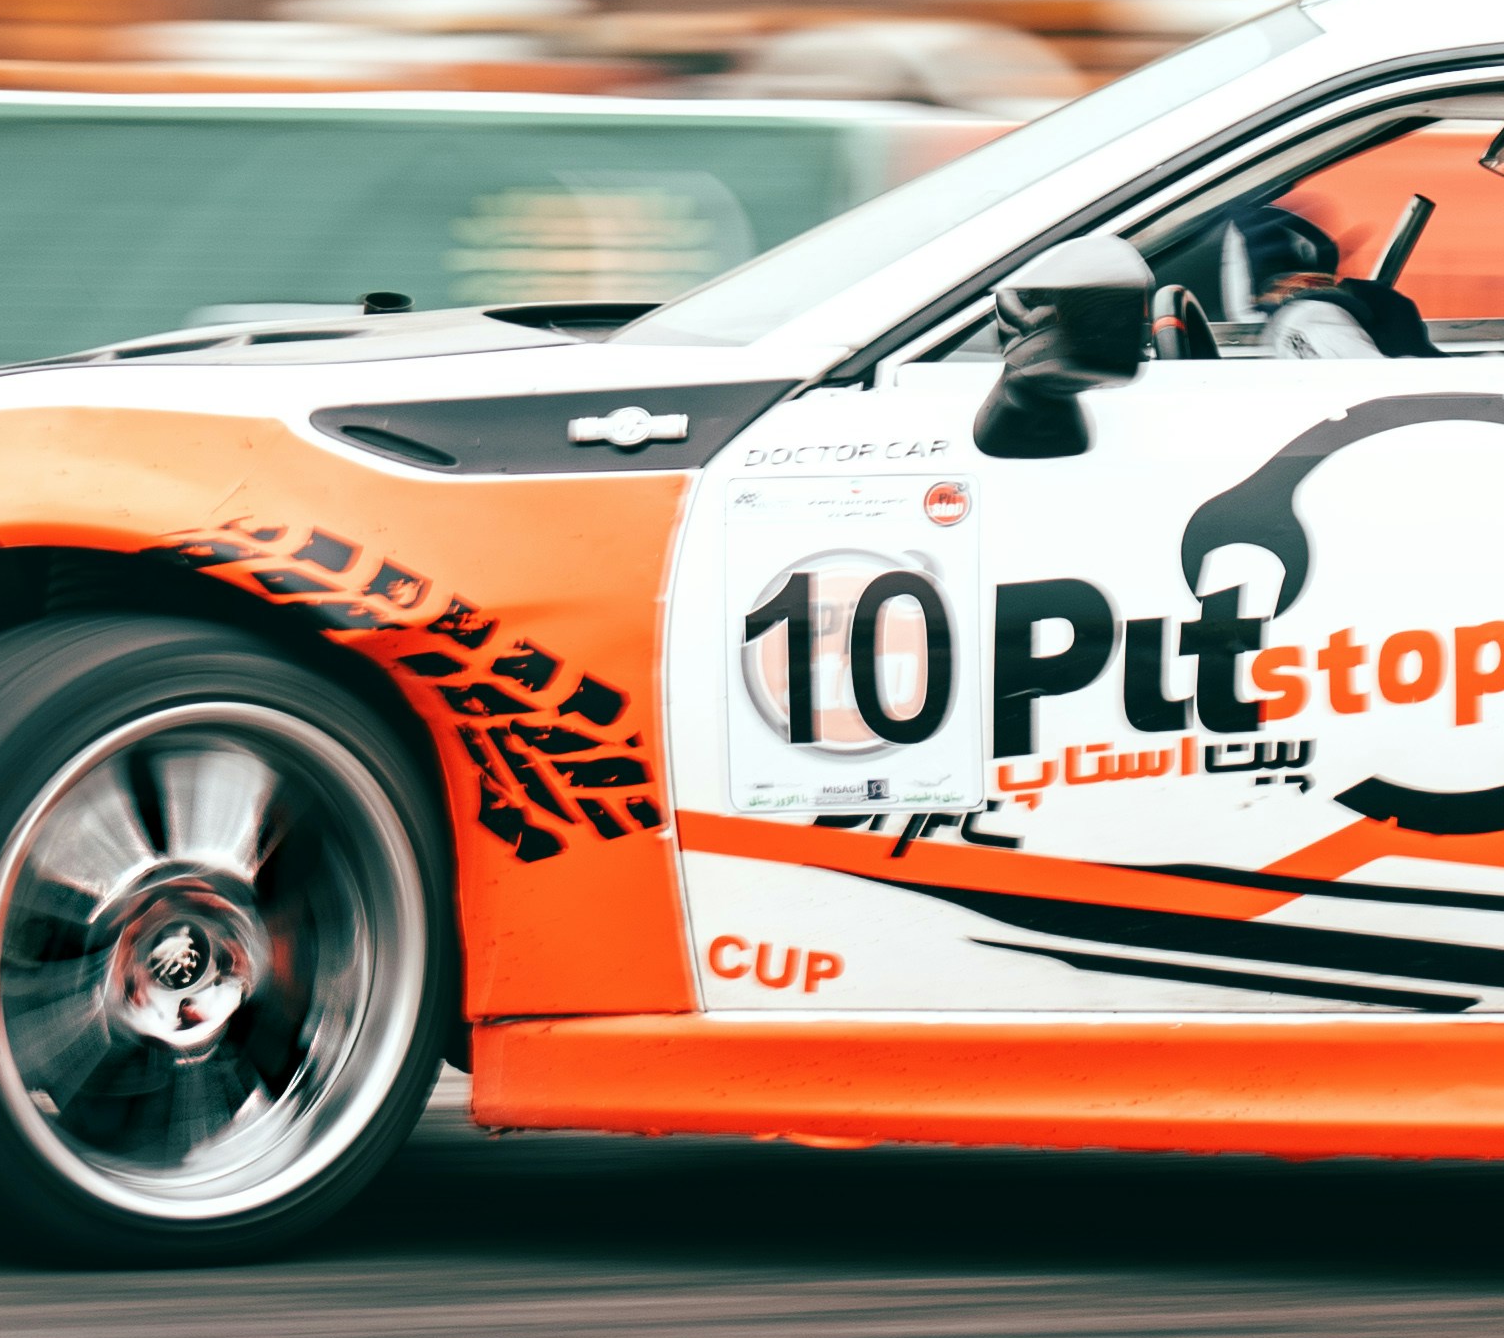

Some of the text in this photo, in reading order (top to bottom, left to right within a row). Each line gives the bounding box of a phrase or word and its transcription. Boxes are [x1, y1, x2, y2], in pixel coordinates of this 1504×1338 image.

[744, 440, 949, 466] DOCTOR CAR
[744, 570, 953, 745] 10
[707, 934, 846, 994] CUP
